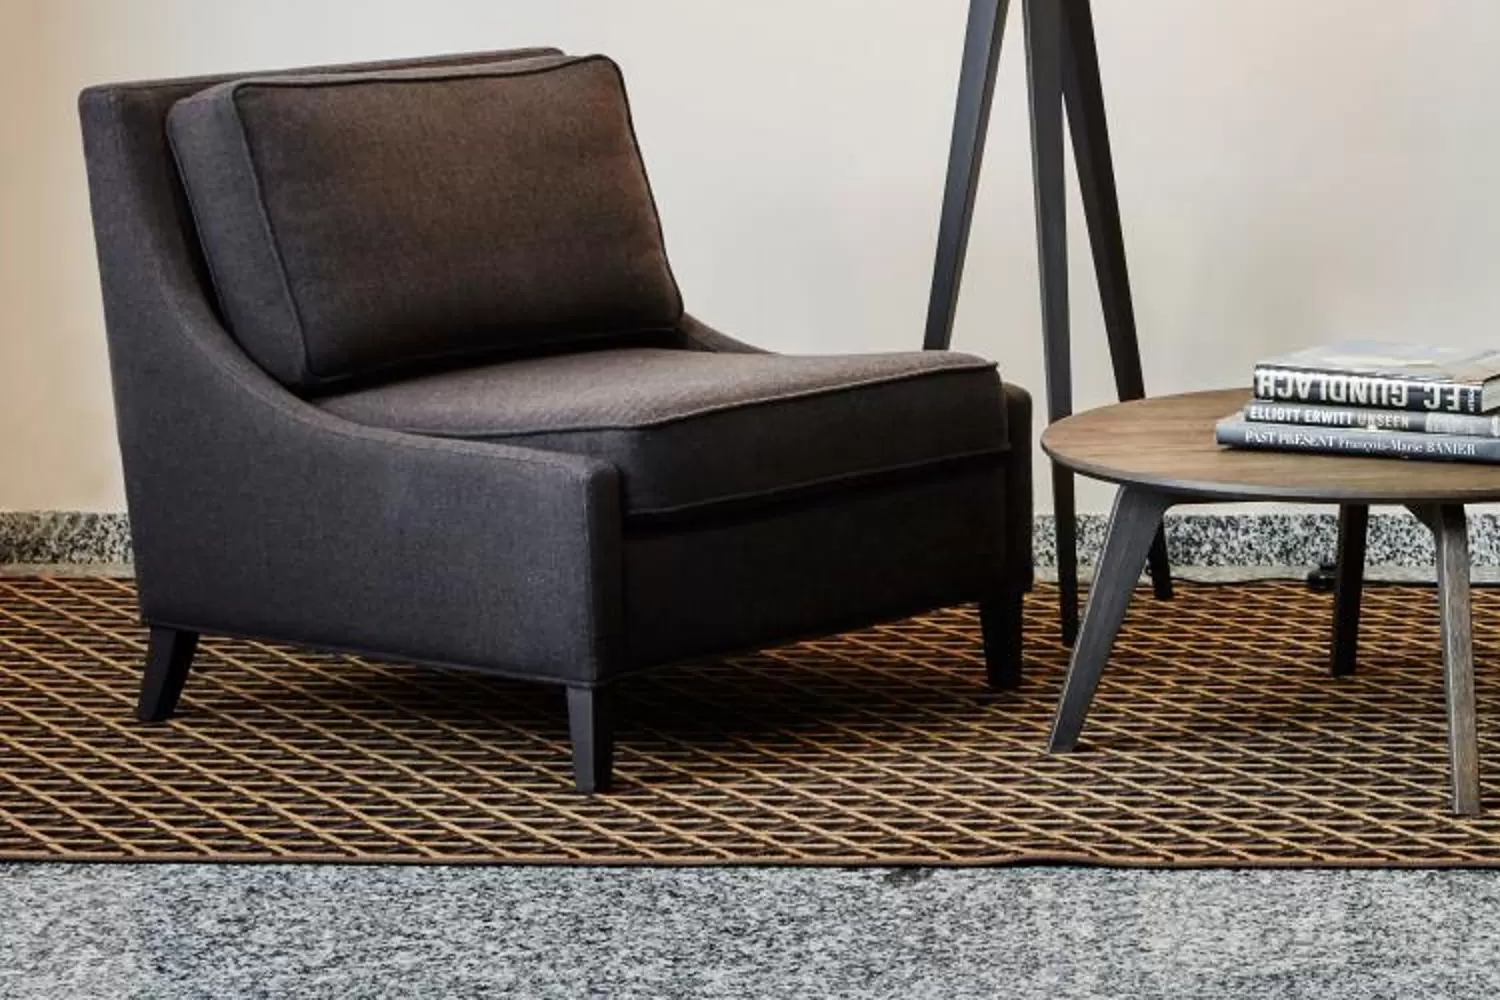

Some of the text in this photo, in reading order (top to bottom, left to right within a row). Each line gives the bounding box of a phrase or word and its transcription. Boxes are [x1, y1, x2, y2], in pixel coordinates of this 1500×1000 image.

[1256, 371, 1408, 406] GUNDLACH
[1251, 405, 1301, 421] ELLIOTT
[1304, 408, 1353, 425] ERWITT
[1245, 430, 1277, 443] PAST
[1278, 433, 1337, 447] PRESENT
